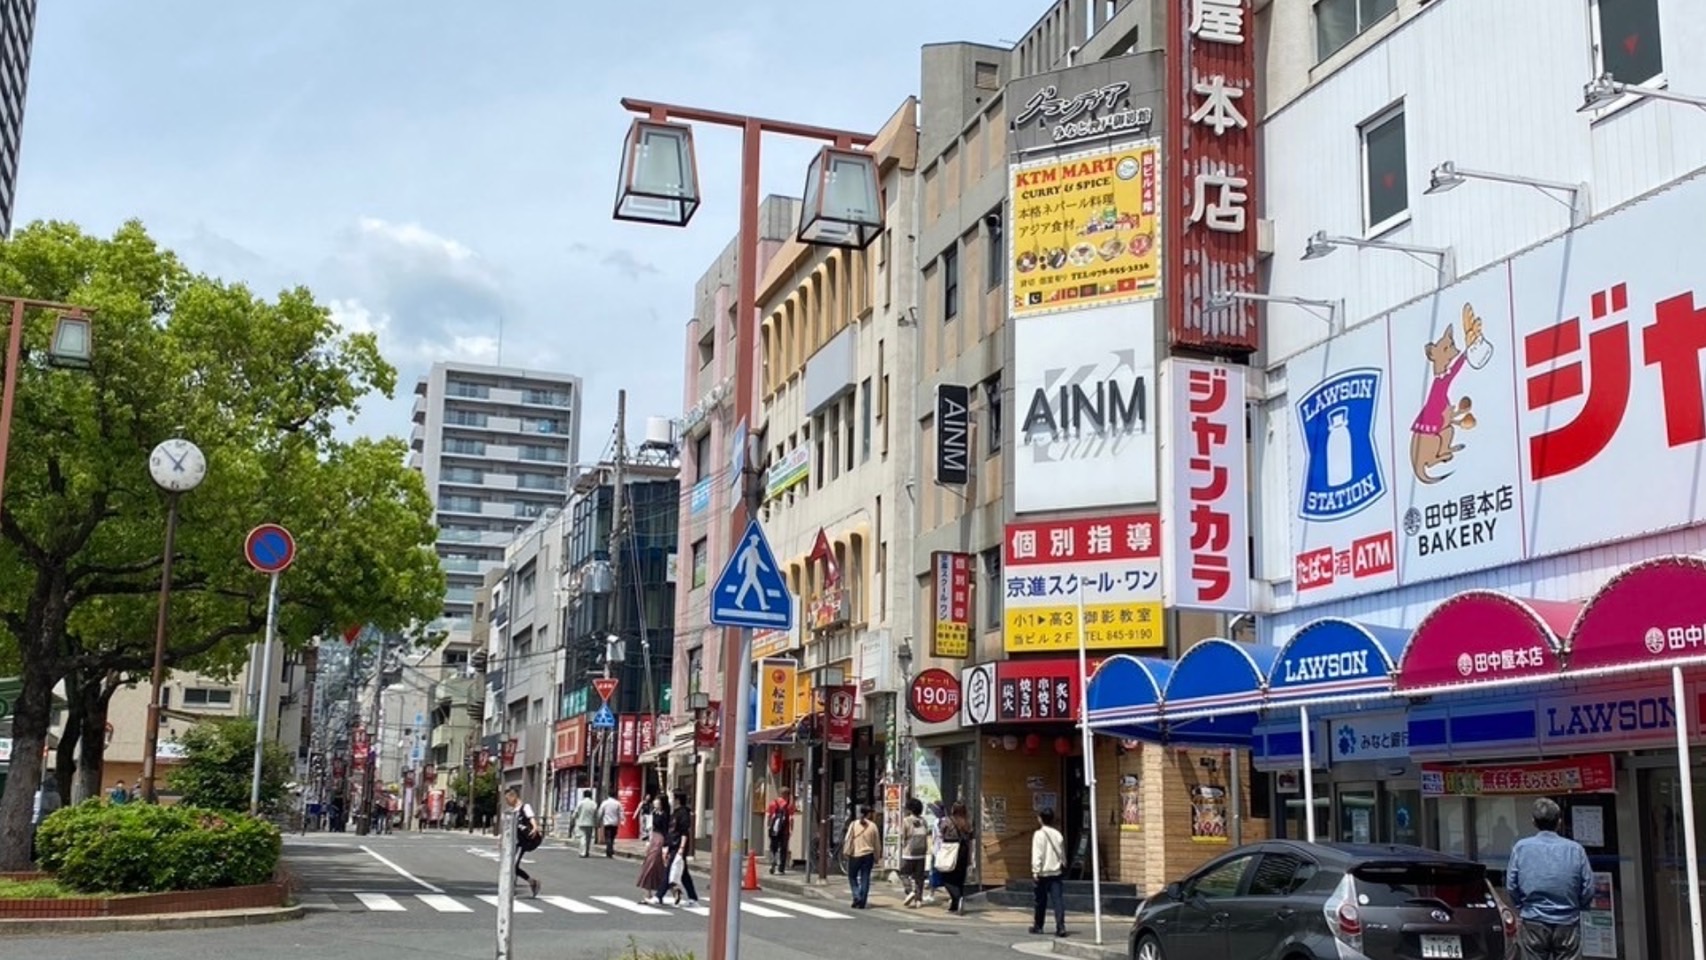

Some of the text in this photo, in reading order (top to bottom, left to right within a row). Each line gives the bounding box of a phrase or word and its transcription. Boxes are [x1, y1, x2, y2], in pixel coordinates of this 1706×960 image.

[1016, 157, 1118, 187] KTM MART
[1021, 177, 1112, 200] CURRY & SPICE
[1018, 193, 1116, 219] 本格ネパール料理
[1019, 218, 1076, 238] アジア食材
[1022, 376, 1147, 433] AINM
[1304, 377, 1374, 422] LAWSON
[943, 397, 966, 471] AINM
[1189, 368, 1232, 602] ジャンカラ
[1307, 473, 1377, 512] STATION
[1424, 484, 1514, 530] 田中屋本店
[1011, 523, 1153, 559] 個別指導
[1418, 517, 1498, 557] BAKERY
[1297, 538, 1391, 582] たばこ 酒 ATM
[1050, 611, 1073, 627] 高3
[1084, 608, 1152, 625] 御影教室
[1054, 631, 1073, 643] 2F
[1085, 631, 1103, 642] TEL
[1106, 629, 1153, 642] 845-9190
[1667, 623, 1706, 650] 田中
[1284, 649, 1369, 683] LAWSON
[1474, 647, 1544, 674] 田中屋本店
[914, 686, 959, 705] 190円
[1003, 684, 1015, 712] 炭火
[1020, 678, 1032, 718] 焼き鳥
[1055, 682, 1068, 712] 炙り
[1547, 697, 1677, 737] LAWSON
